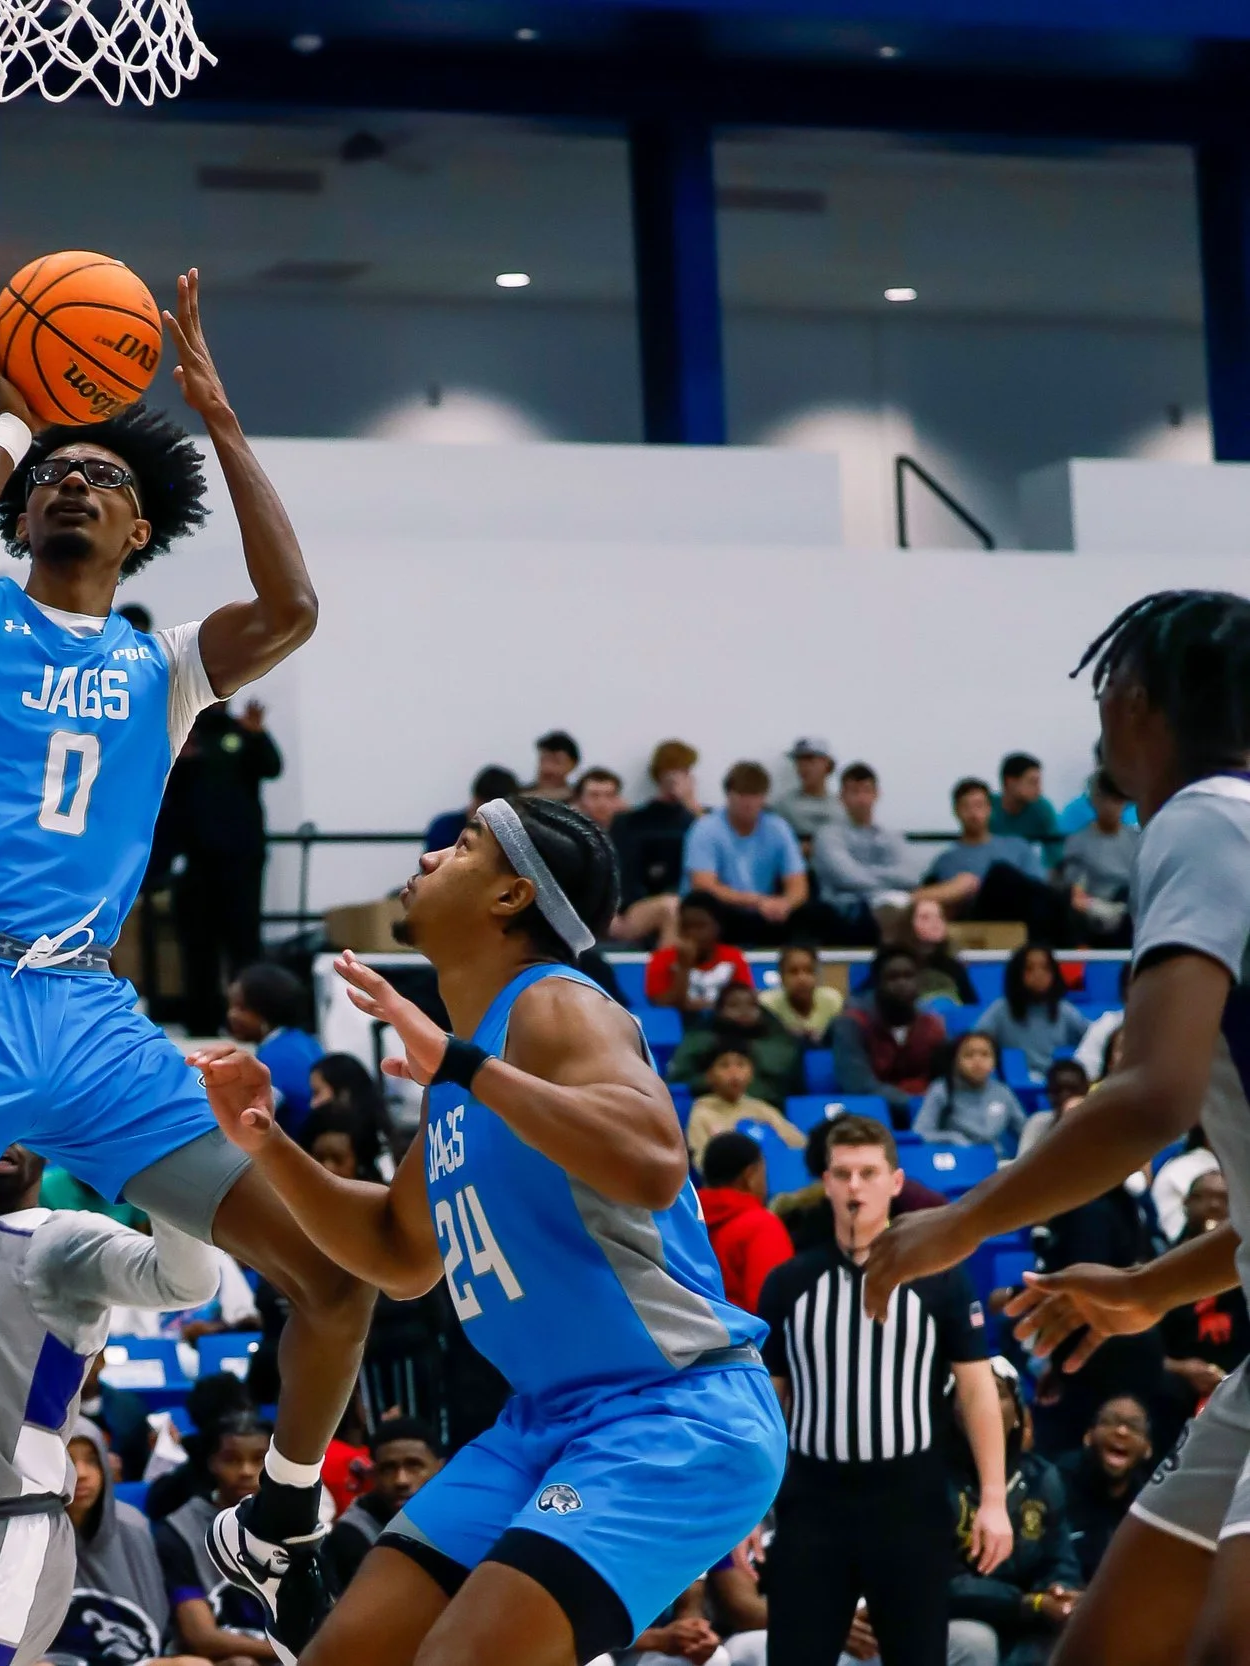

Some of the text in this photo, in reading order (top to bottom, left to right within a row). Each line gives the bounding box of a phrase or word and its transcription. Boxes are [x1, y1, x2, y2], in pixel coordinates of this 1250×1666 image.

[22, 665, 130, 720] JAGS
[112, 647, 151, 661] PBC
[38, 730, 101, 836] 0
[428, 1104, 465, 1184] JAGS
[435, 1185, 525, 1322] 24
